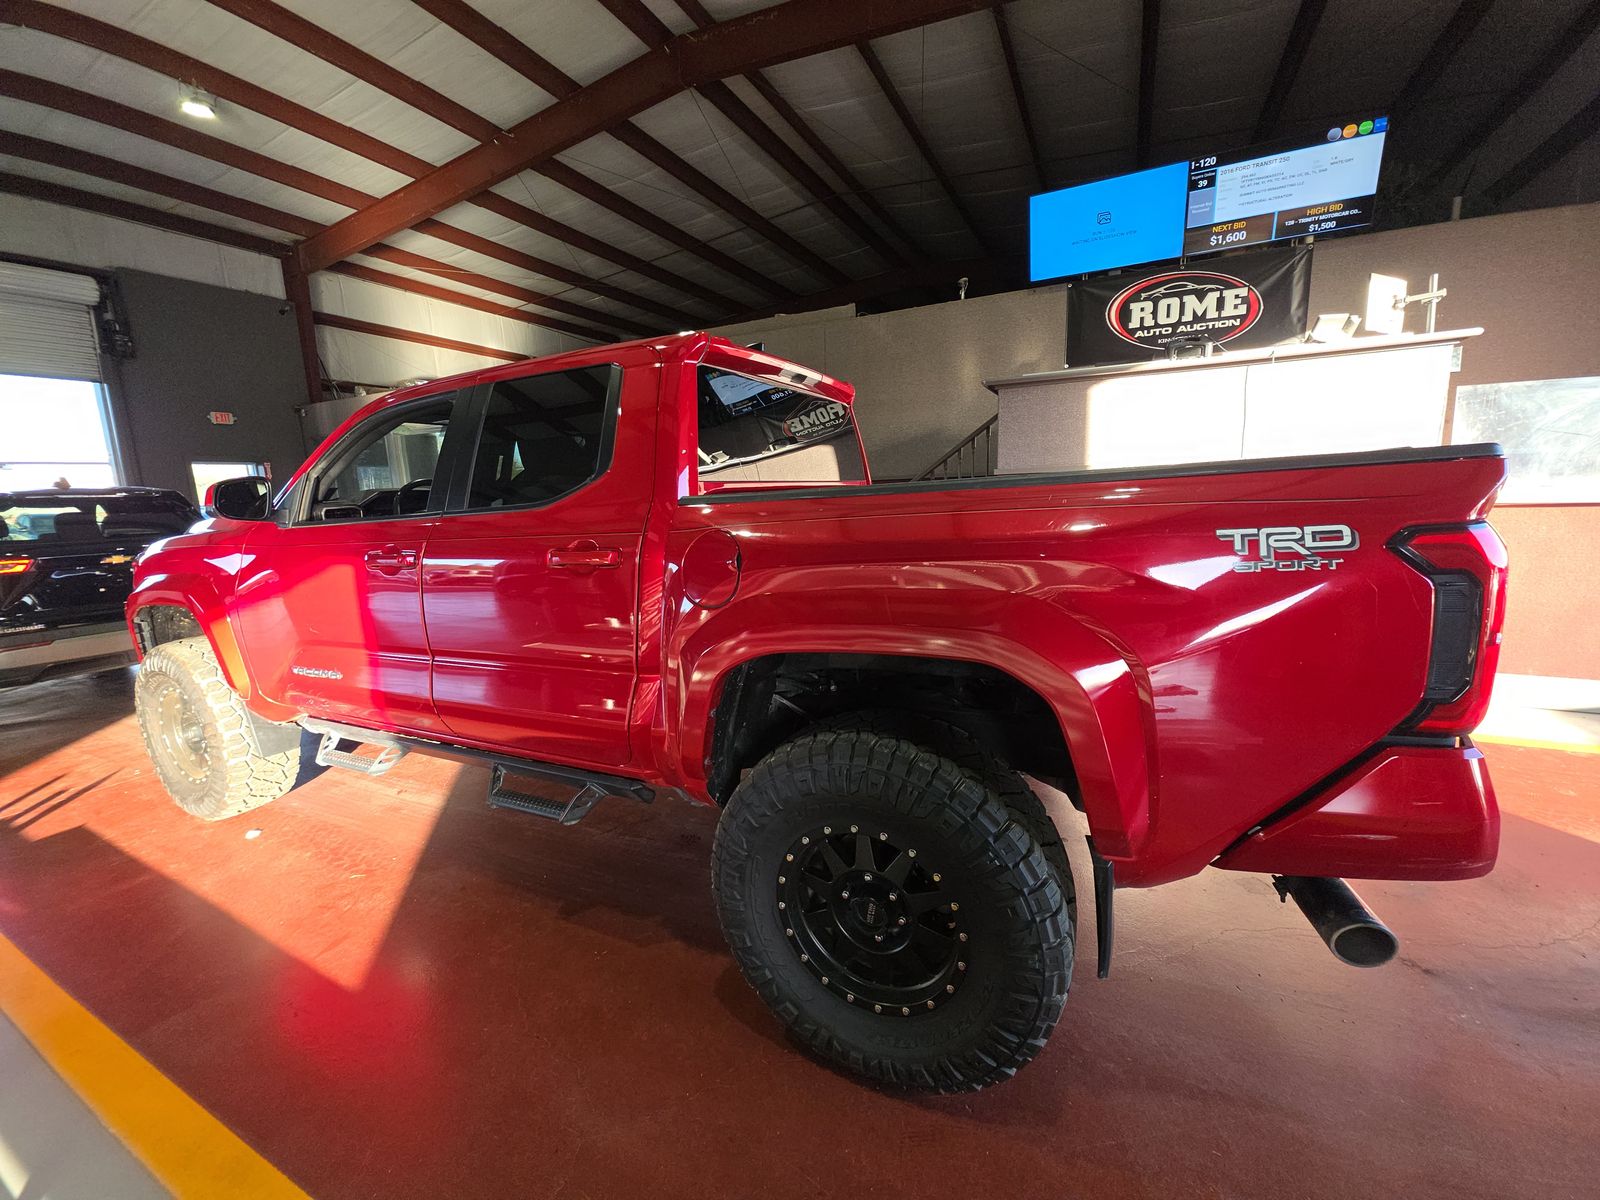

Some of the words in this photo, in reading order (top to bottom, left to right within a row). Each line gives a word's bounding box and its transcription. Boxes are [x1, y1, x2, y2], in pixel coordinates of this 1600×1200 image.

[1235, 164, 1251, 173] FORD
[1252, 158, 1278, 169] TRANSIT
[1197, 180, 1208, 188] 39
[1306, 205, 1329, 216] HIGH
[1329, 203, 1344, 213] BID
[1212, 223, 1233, 233] NEXT
[1233, 221, 1247, 230] BID
[1308, 220, 1337, 233] $1,500
[1209, 231, 1247, 246] $1,600
[1128, 286, 1249, 329] ROME
[1133, 326, 1173, 338] AUTO
[1176, 318, 1241, 334] AUCTION
[1216, 524, 1360, 561] TRD
[1233, 557, 1345, 573] SPORT
